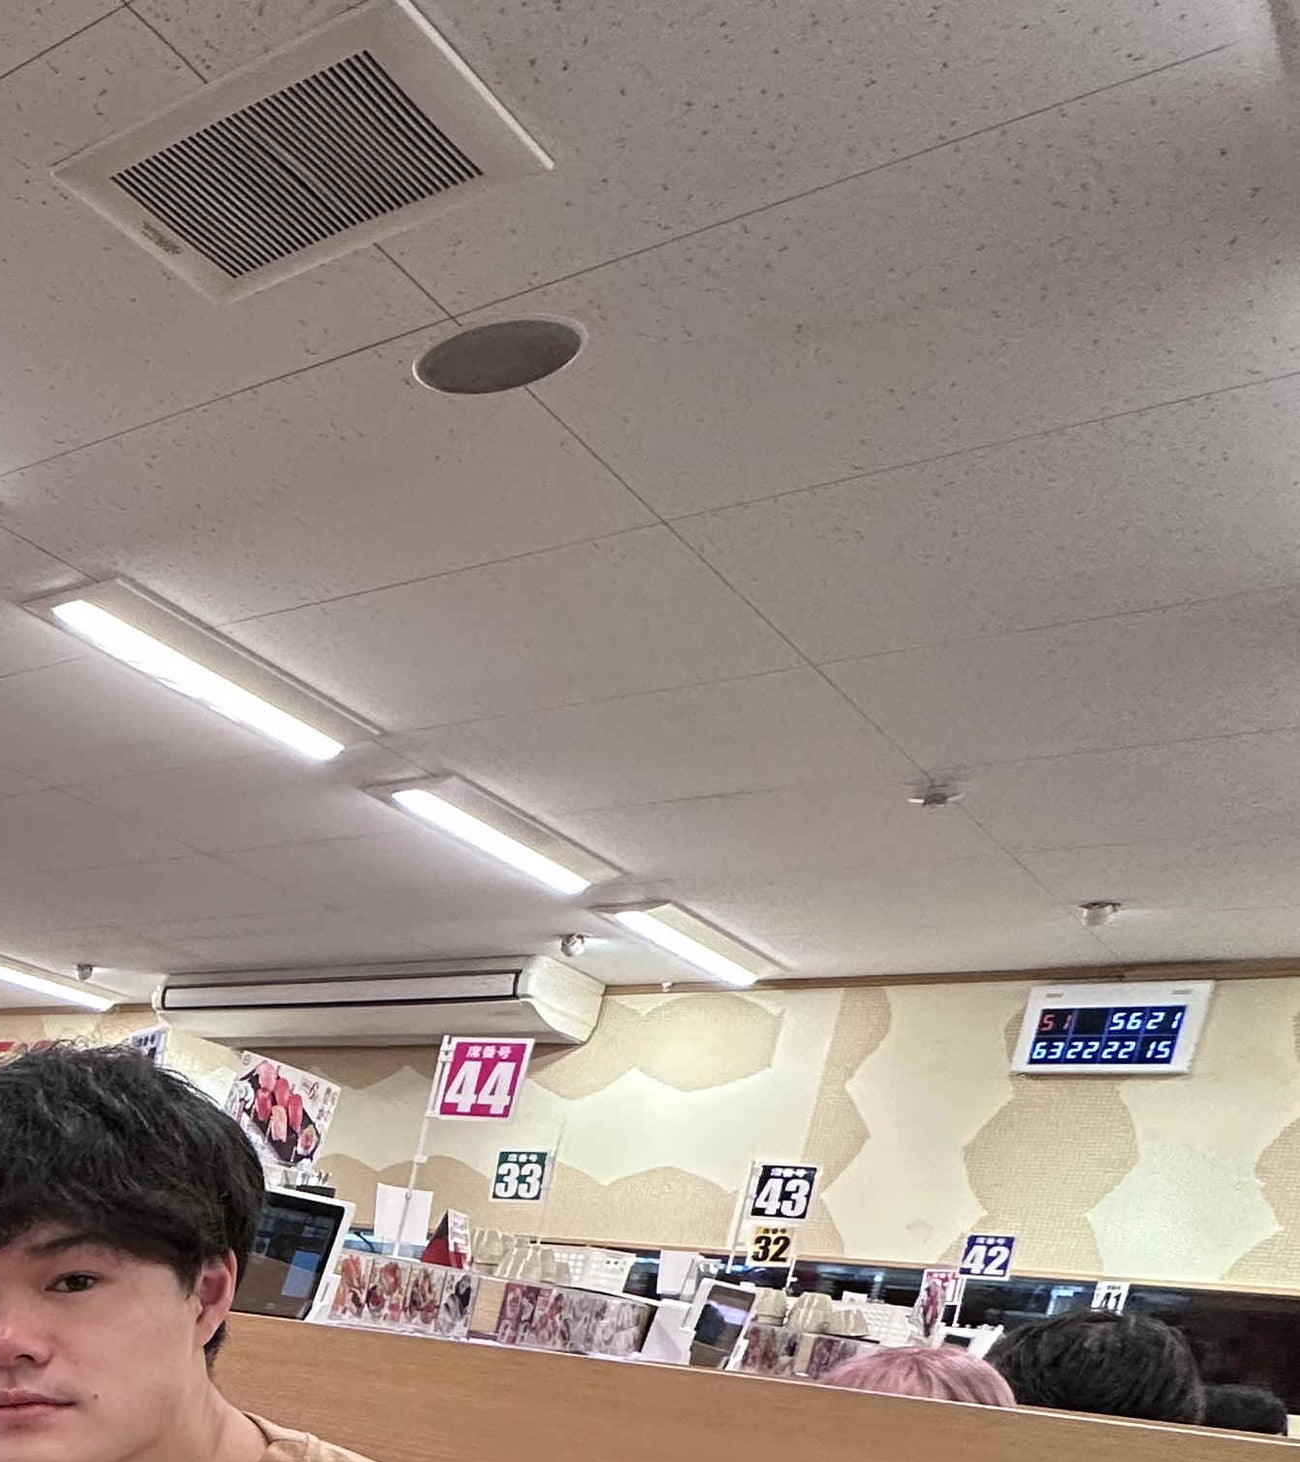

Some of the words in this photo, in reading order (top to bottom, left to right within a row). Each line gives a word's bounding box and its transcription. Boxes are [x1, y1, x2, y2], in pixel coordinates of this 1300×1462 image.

[444, 1060, 517, 1115] 44
[494, 1163, 543, 1199] 33
[754, 1177, 811, 1217] 43
[751, 1234, 791, 1263] 32
[962, 1244, 1015, 1277] 42
